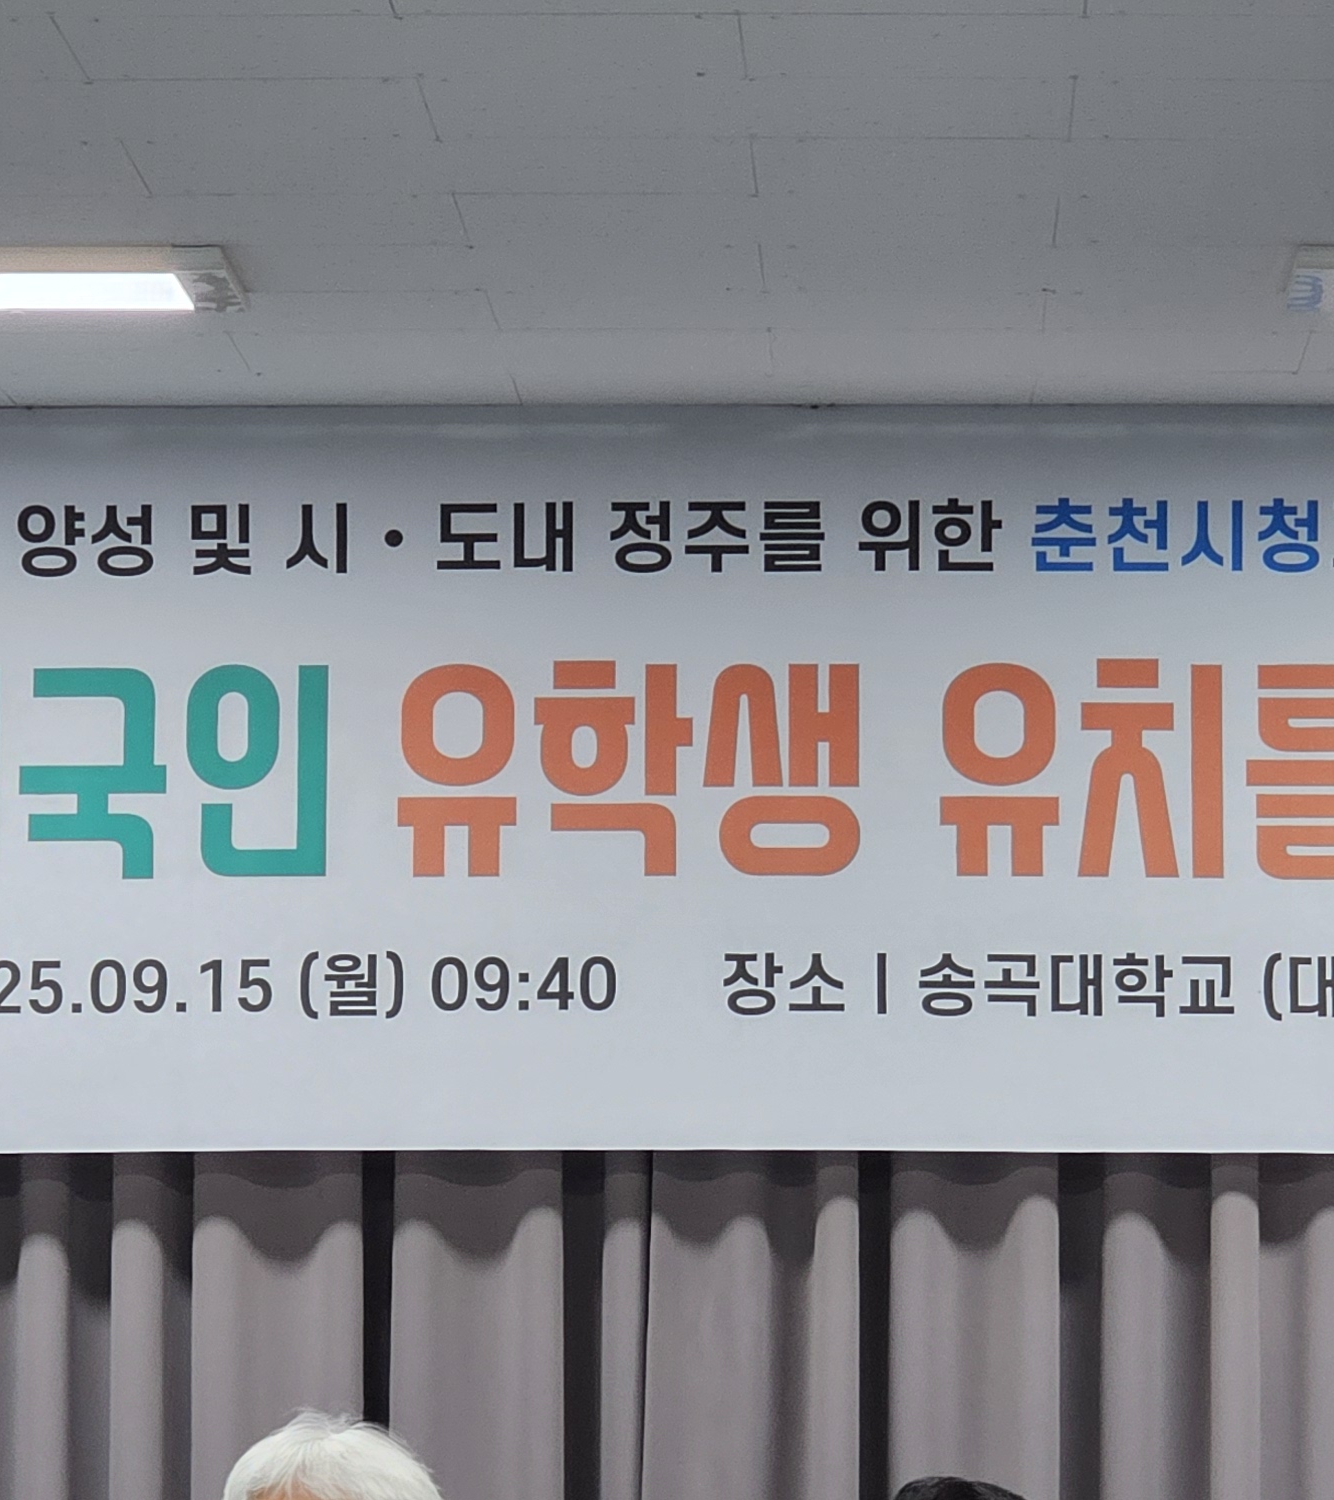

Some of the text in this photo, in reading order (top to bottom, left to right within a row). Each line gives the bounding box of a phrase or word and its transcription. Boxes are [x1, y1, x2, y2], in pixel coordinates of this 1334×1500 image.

[19, 506, 154, 578] 양성
[192, 505, 252, 576] 및
[611, 502, 826, 574] 정주를
[860, 499, 1003, 572] 위한
[399, 660, 861, 879] 유학생
[301, 952, 405, 1021] (월)
[432, 956, 618, 1013] 09:40
[725, 953, 847, 1017] 장소
[920, 953, 1235, 1019] 송곡대학교
